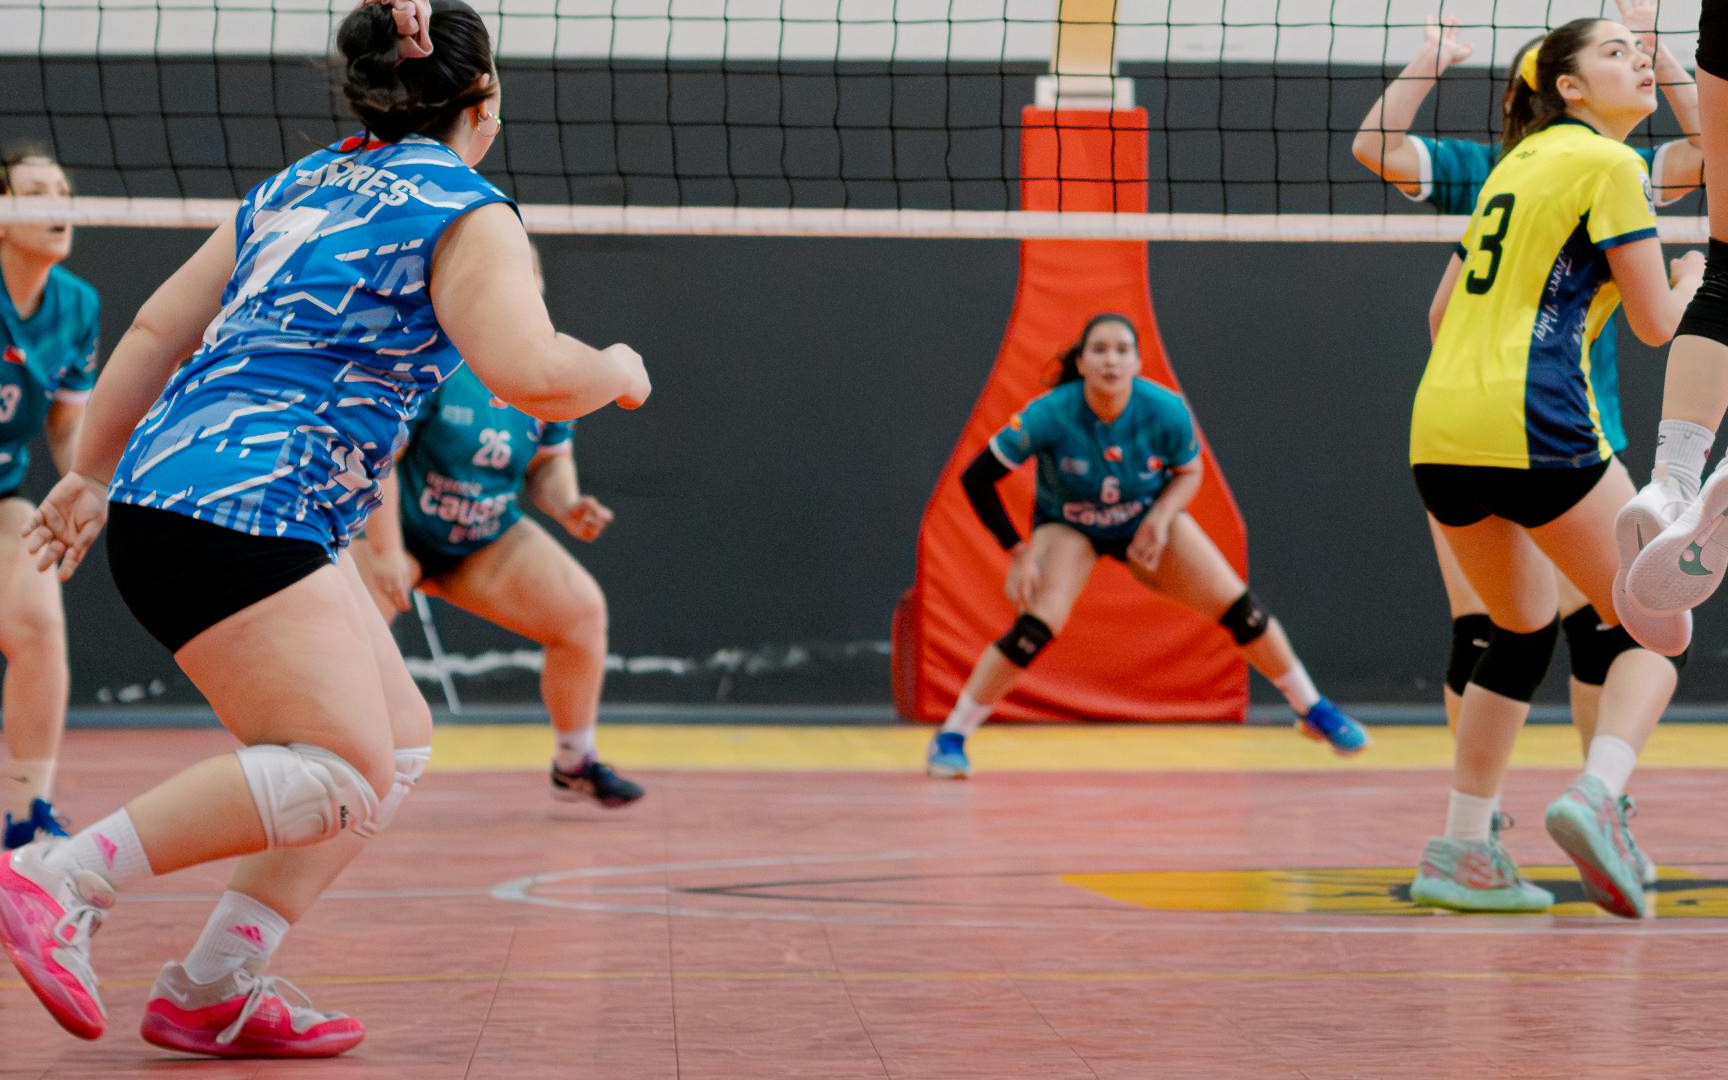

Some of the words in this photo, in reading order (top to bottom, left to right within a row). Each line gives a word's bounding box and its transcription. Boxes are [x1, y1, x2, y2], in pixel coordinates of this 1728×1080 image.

[203, 206, 330, 352] 7
[1465, 192, 1516, 295] 3
[472, 428, 512, 469] 26
[1101, 475, 1120, 504] 6
